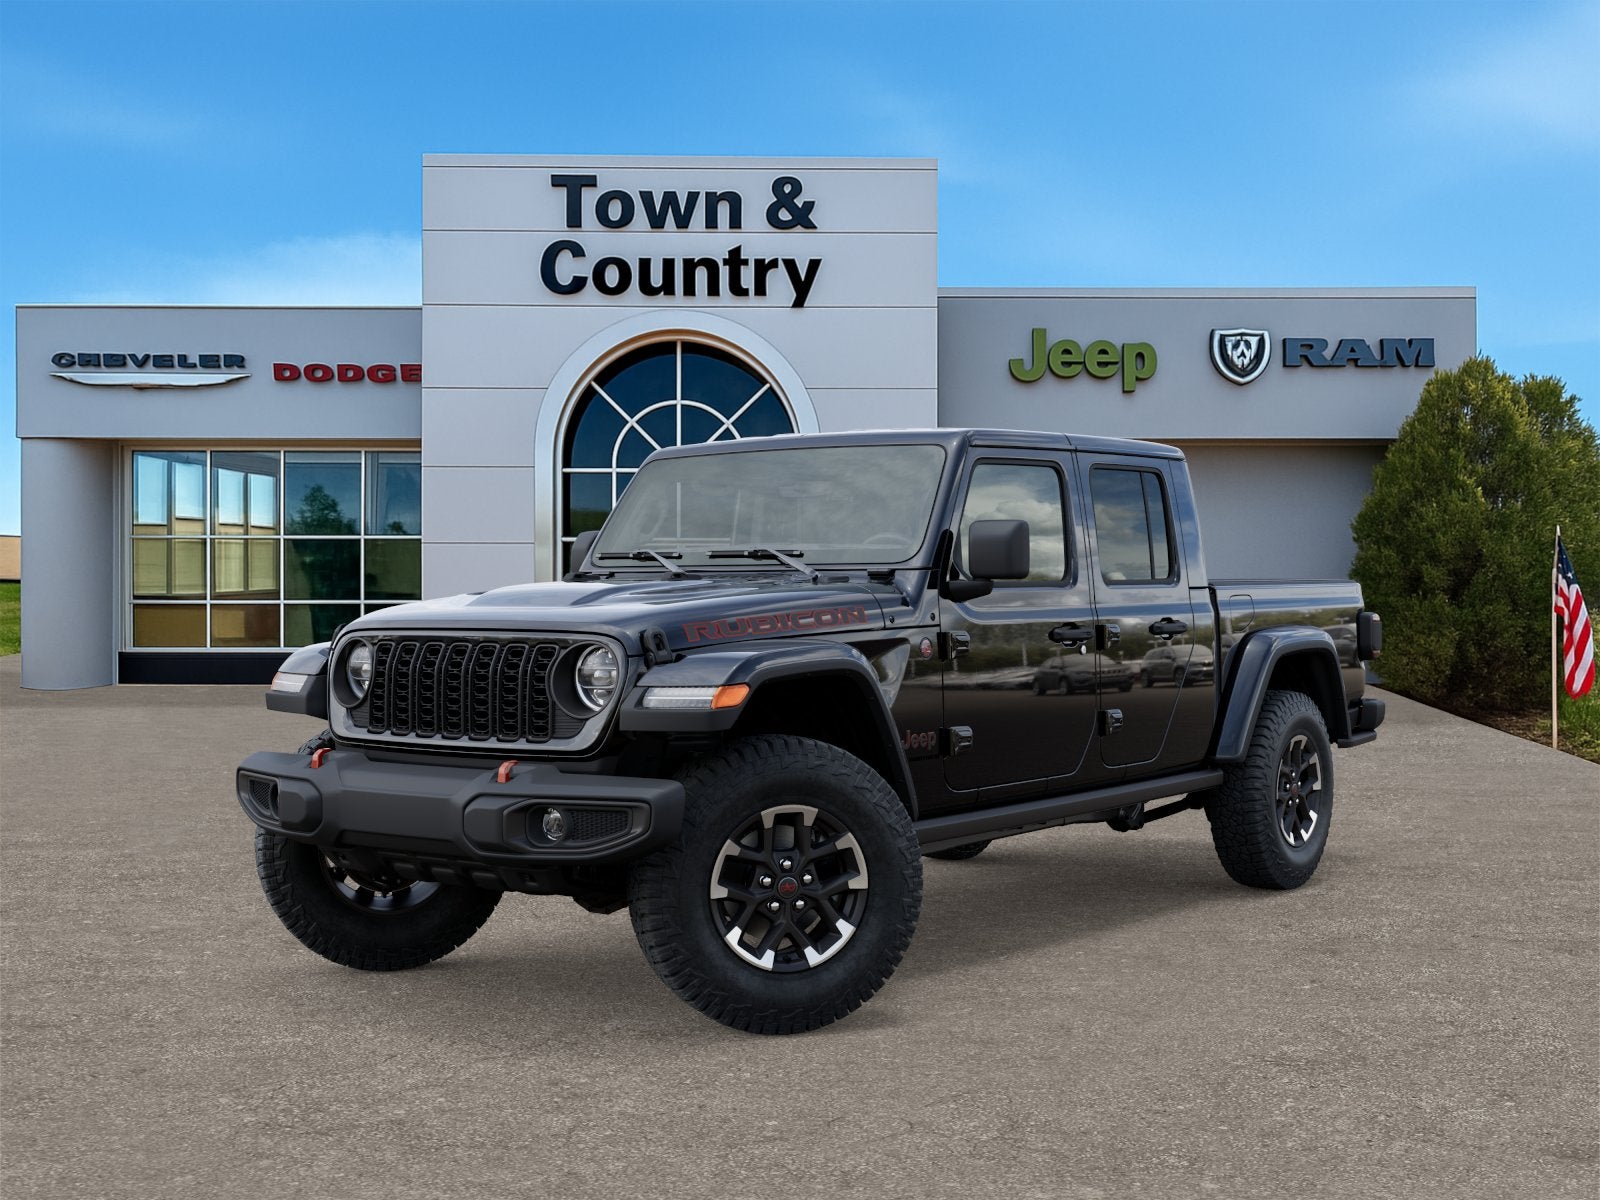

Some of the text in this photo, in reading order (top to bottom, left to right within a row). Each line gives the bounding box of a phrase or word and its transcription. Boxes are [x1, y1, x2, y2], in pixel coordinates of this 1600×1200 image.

[551, 174, 818, 230] Town &
[540, 239, 822, 308] Country
[1009, 327, 1158, 393] Jeep
[1282, 337, 1436, 368] RAM
[273, 362, 422, 383] DODGE
[683, 605, 868, 642] RUBICON
[902, 729, 937, 753] Jeep
